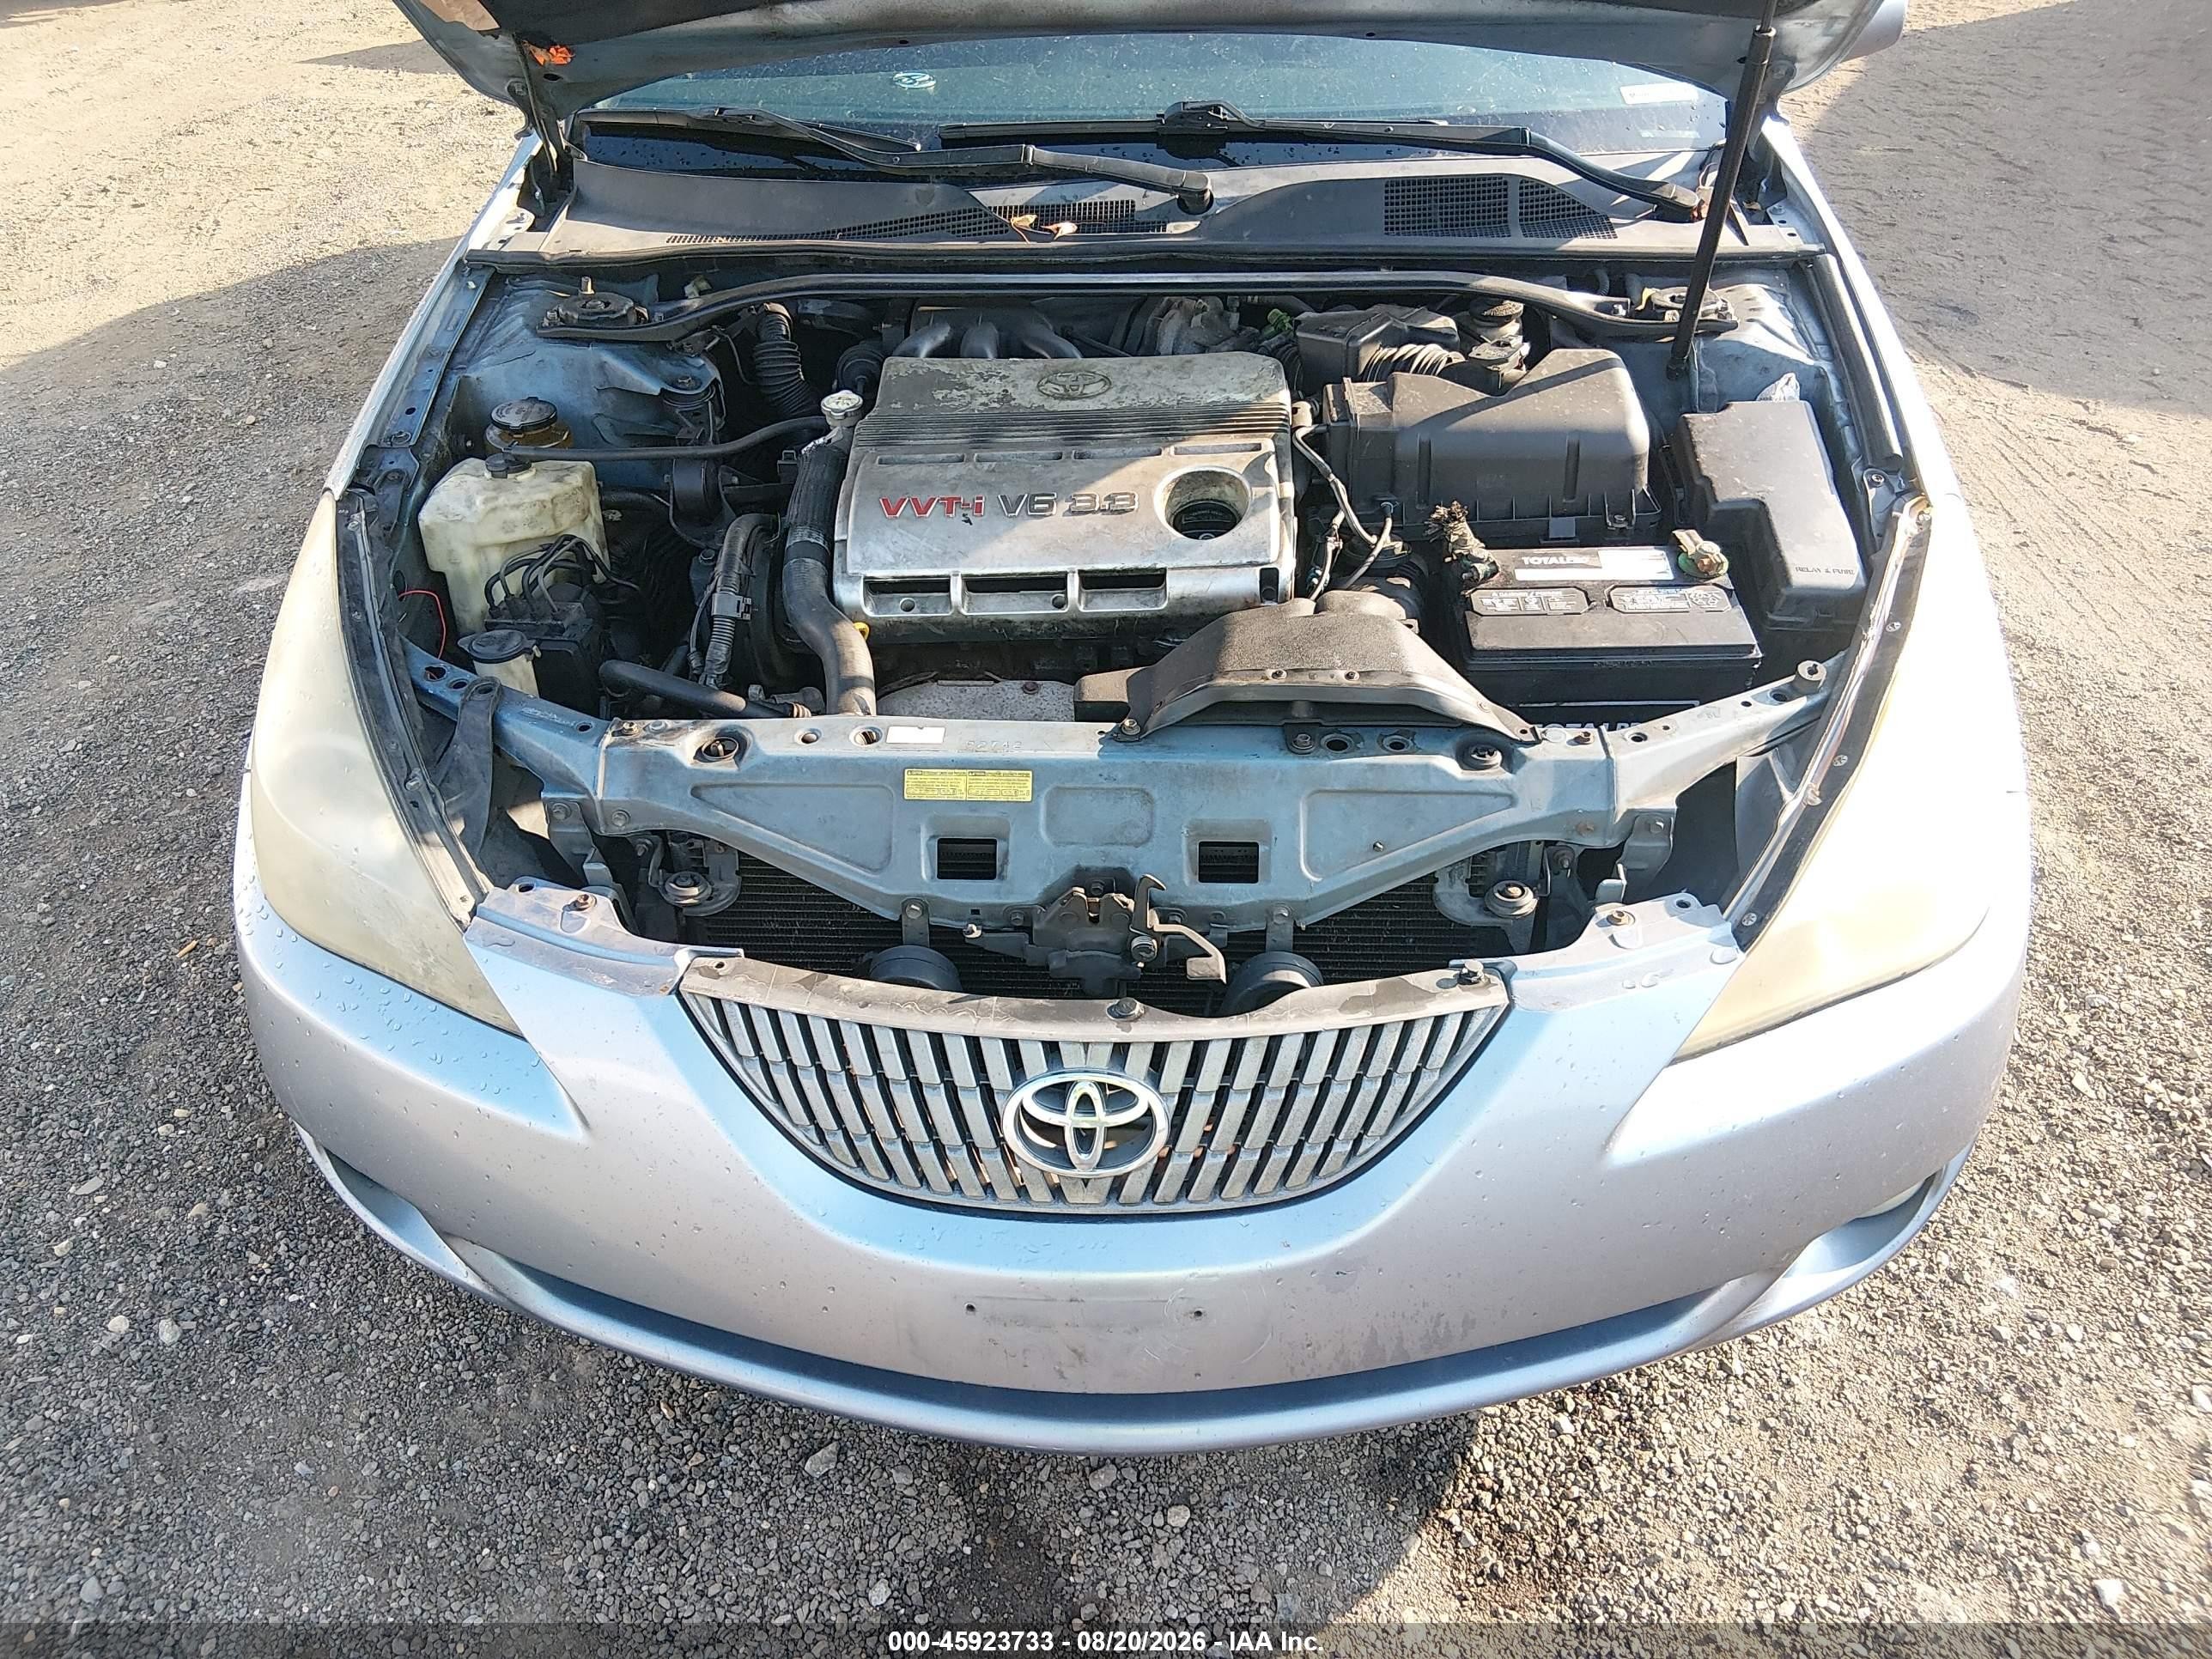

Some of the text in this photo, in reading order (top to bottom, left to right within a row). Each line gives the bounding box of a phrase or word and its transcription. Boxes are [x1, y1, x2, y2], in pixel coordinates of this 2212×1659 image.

[878, 492, 1139, 518] VVT-i V6 3.3
